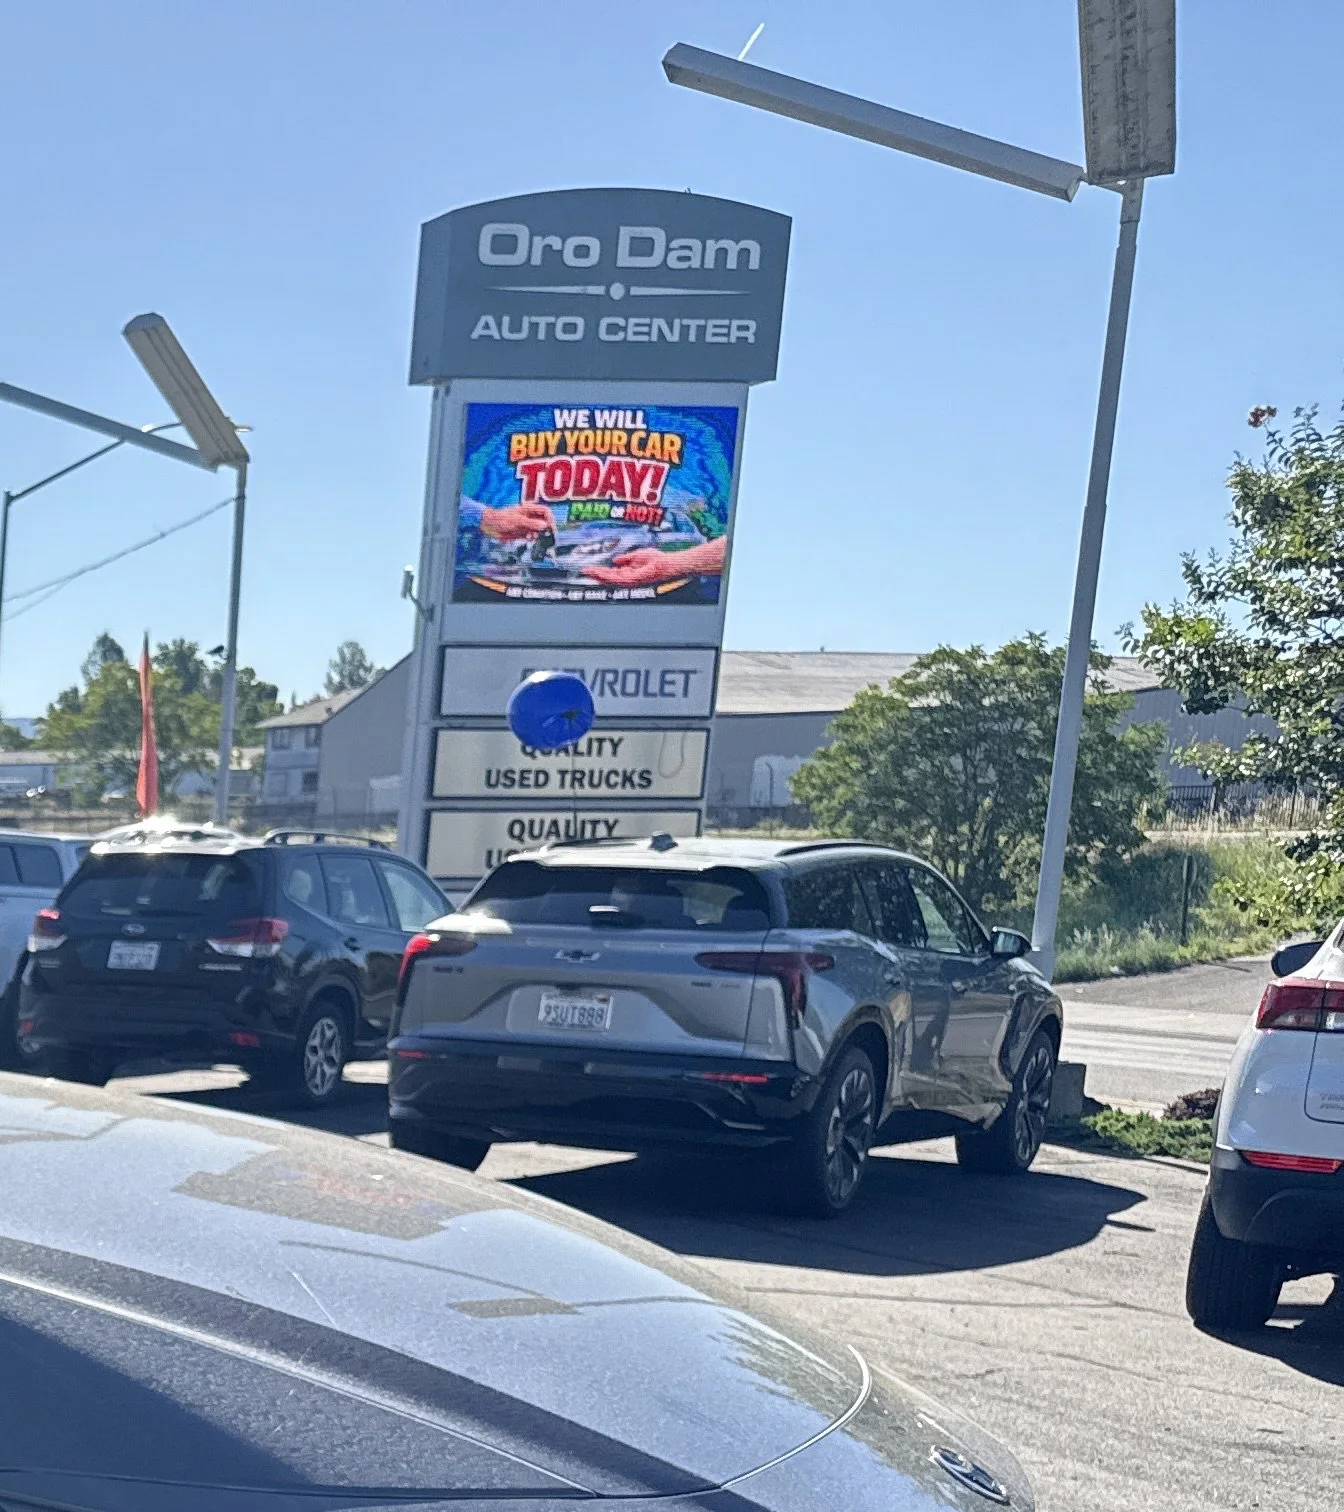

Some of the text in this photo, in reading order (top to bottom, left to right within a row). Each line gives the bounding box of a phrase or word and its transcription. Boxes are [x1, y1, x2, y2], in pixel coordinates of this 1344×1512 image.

[478, 222, 761, 270] Oro Dam
[470, 314, 757, 344] AUTO CENTER
[553, 408, 647, 429] WE WILL
[510, 429, 682, 464] BUY YOUR CAR
[518, 456, 668, 504] TODAY!
[569, 502, 610, 521] PAID
[484, 769, 653, 790] USED TRUCKS
[506, 818, 620, 844] QUALITY
